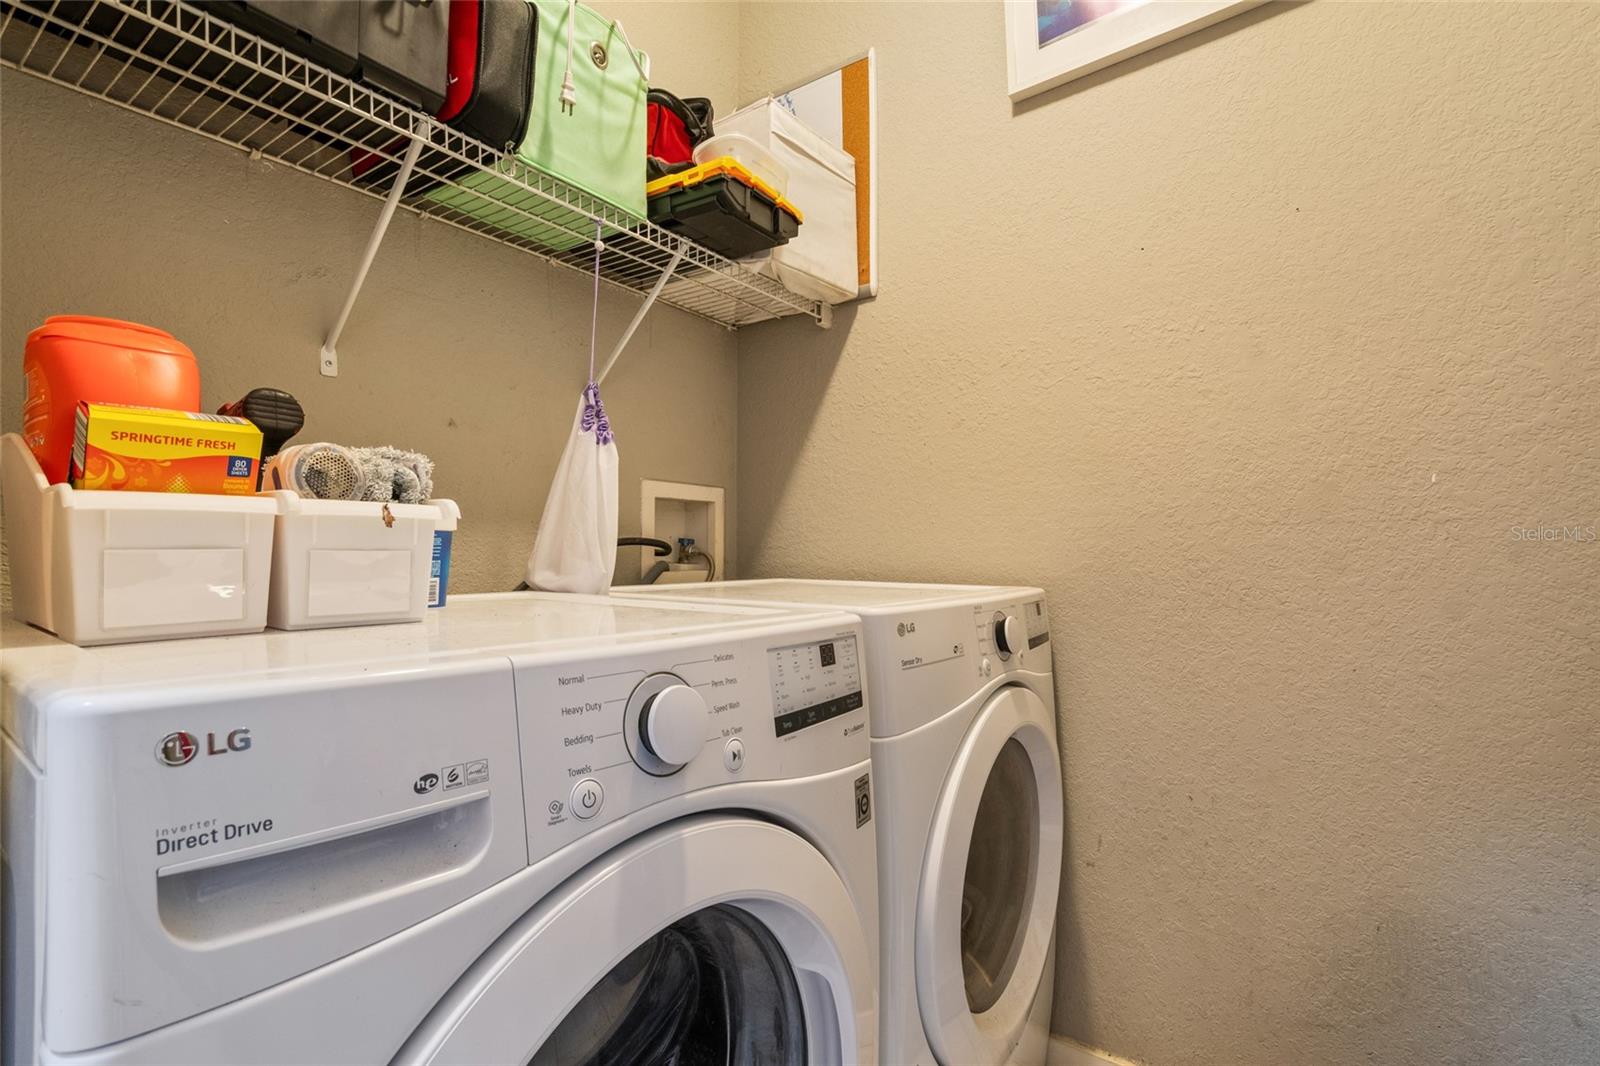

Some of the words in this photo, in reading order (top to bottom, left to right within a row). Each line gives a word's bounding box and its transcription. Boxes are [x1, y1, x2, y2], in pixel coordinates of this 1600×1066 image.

[110, 430, 193, 447] SPRINGTIME
[196, 438, 236, 451] FRESH
[234, 459, 247, 468] 80
[905, 622, 916, 634] LG
[558, 674, 585, 686] Normal
[561, 705, 584, 717] Heavy
[584, 702, 602, 713] Duty
[713, 704, 728, 715] Speed
[207, 727, 252, 756] LG
[564, 734, 594, 748] Bedding
[568, 764, 593, 777] Towels
[155, 817, 217, 838] Inverter
[156, 829, 219, 856] Direct
[224, 818, 273, 841] Drive
